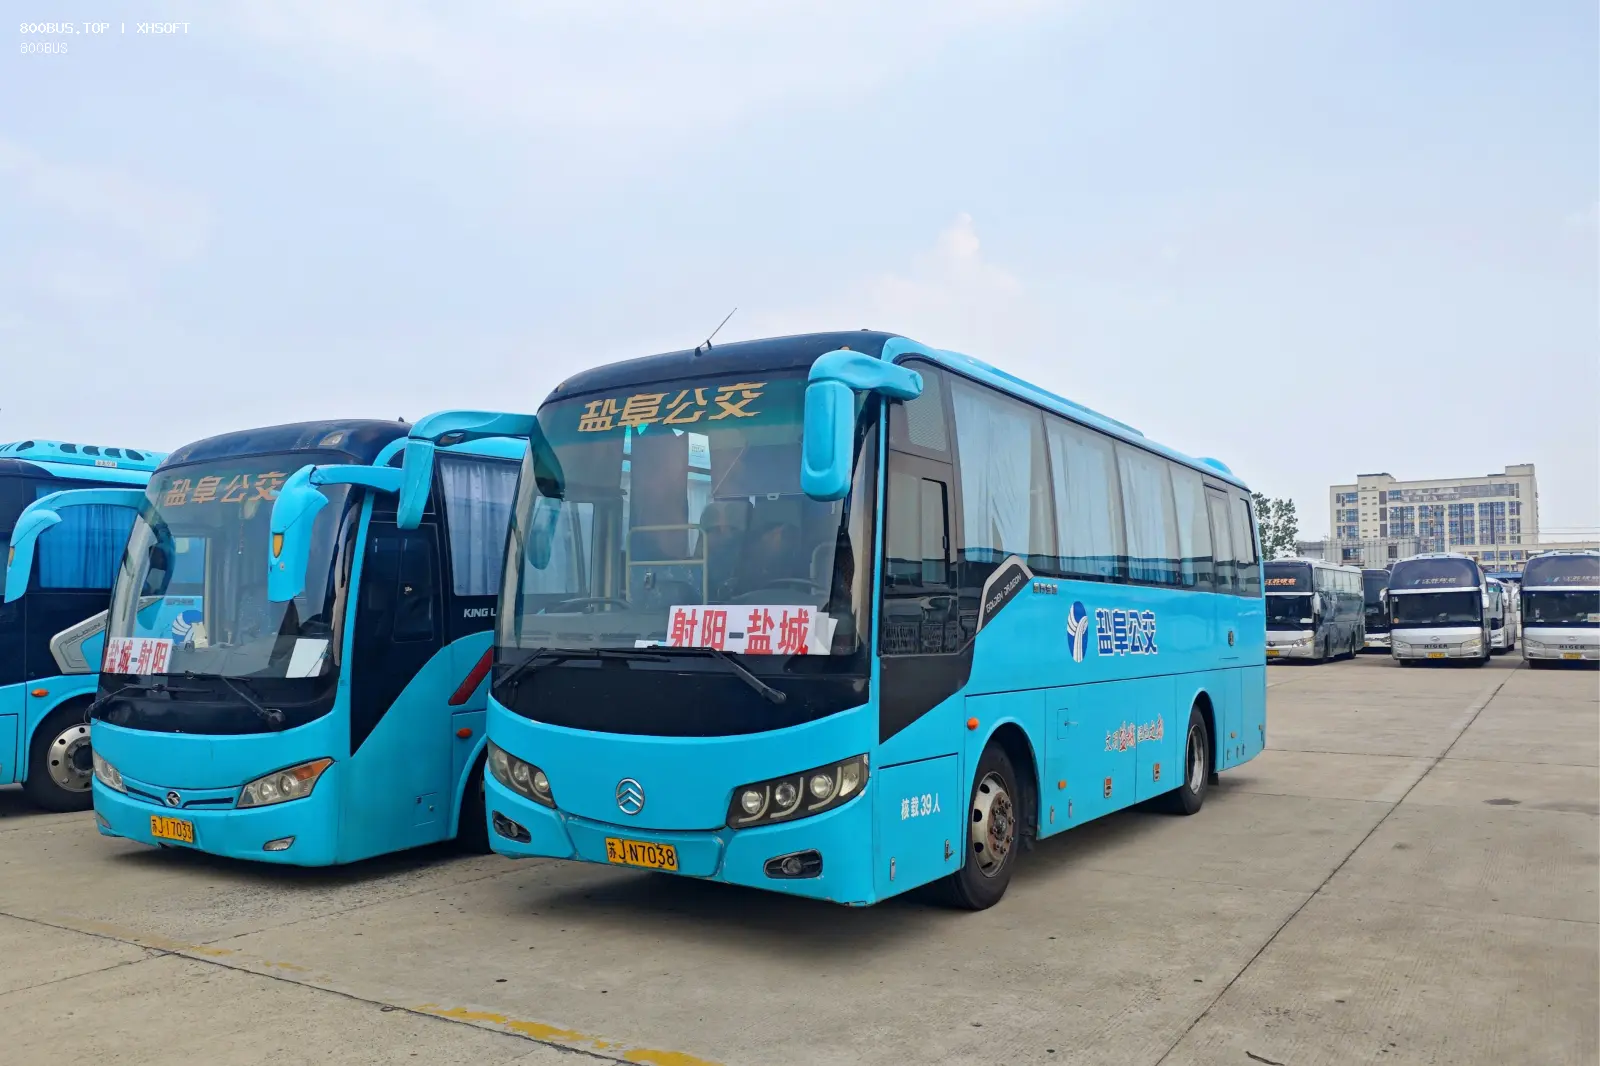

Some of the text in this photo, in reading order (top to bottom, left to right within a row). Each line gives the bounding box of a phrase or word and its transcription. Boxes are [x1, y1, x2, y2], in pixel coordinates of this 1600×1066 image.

[578, 382, 768, 432] 盐阜公交
[164, 471, 288, 507] 盐阜公交
[464, 608, 488, 618] KING
[671, 608, 809, 655] 射阳-盐城
[1094, 608, 1158, 657] 盐阜公交
[106, 639, 169, 675] 盐城-射阳
[901, 792, 941, 821] 核载39人
